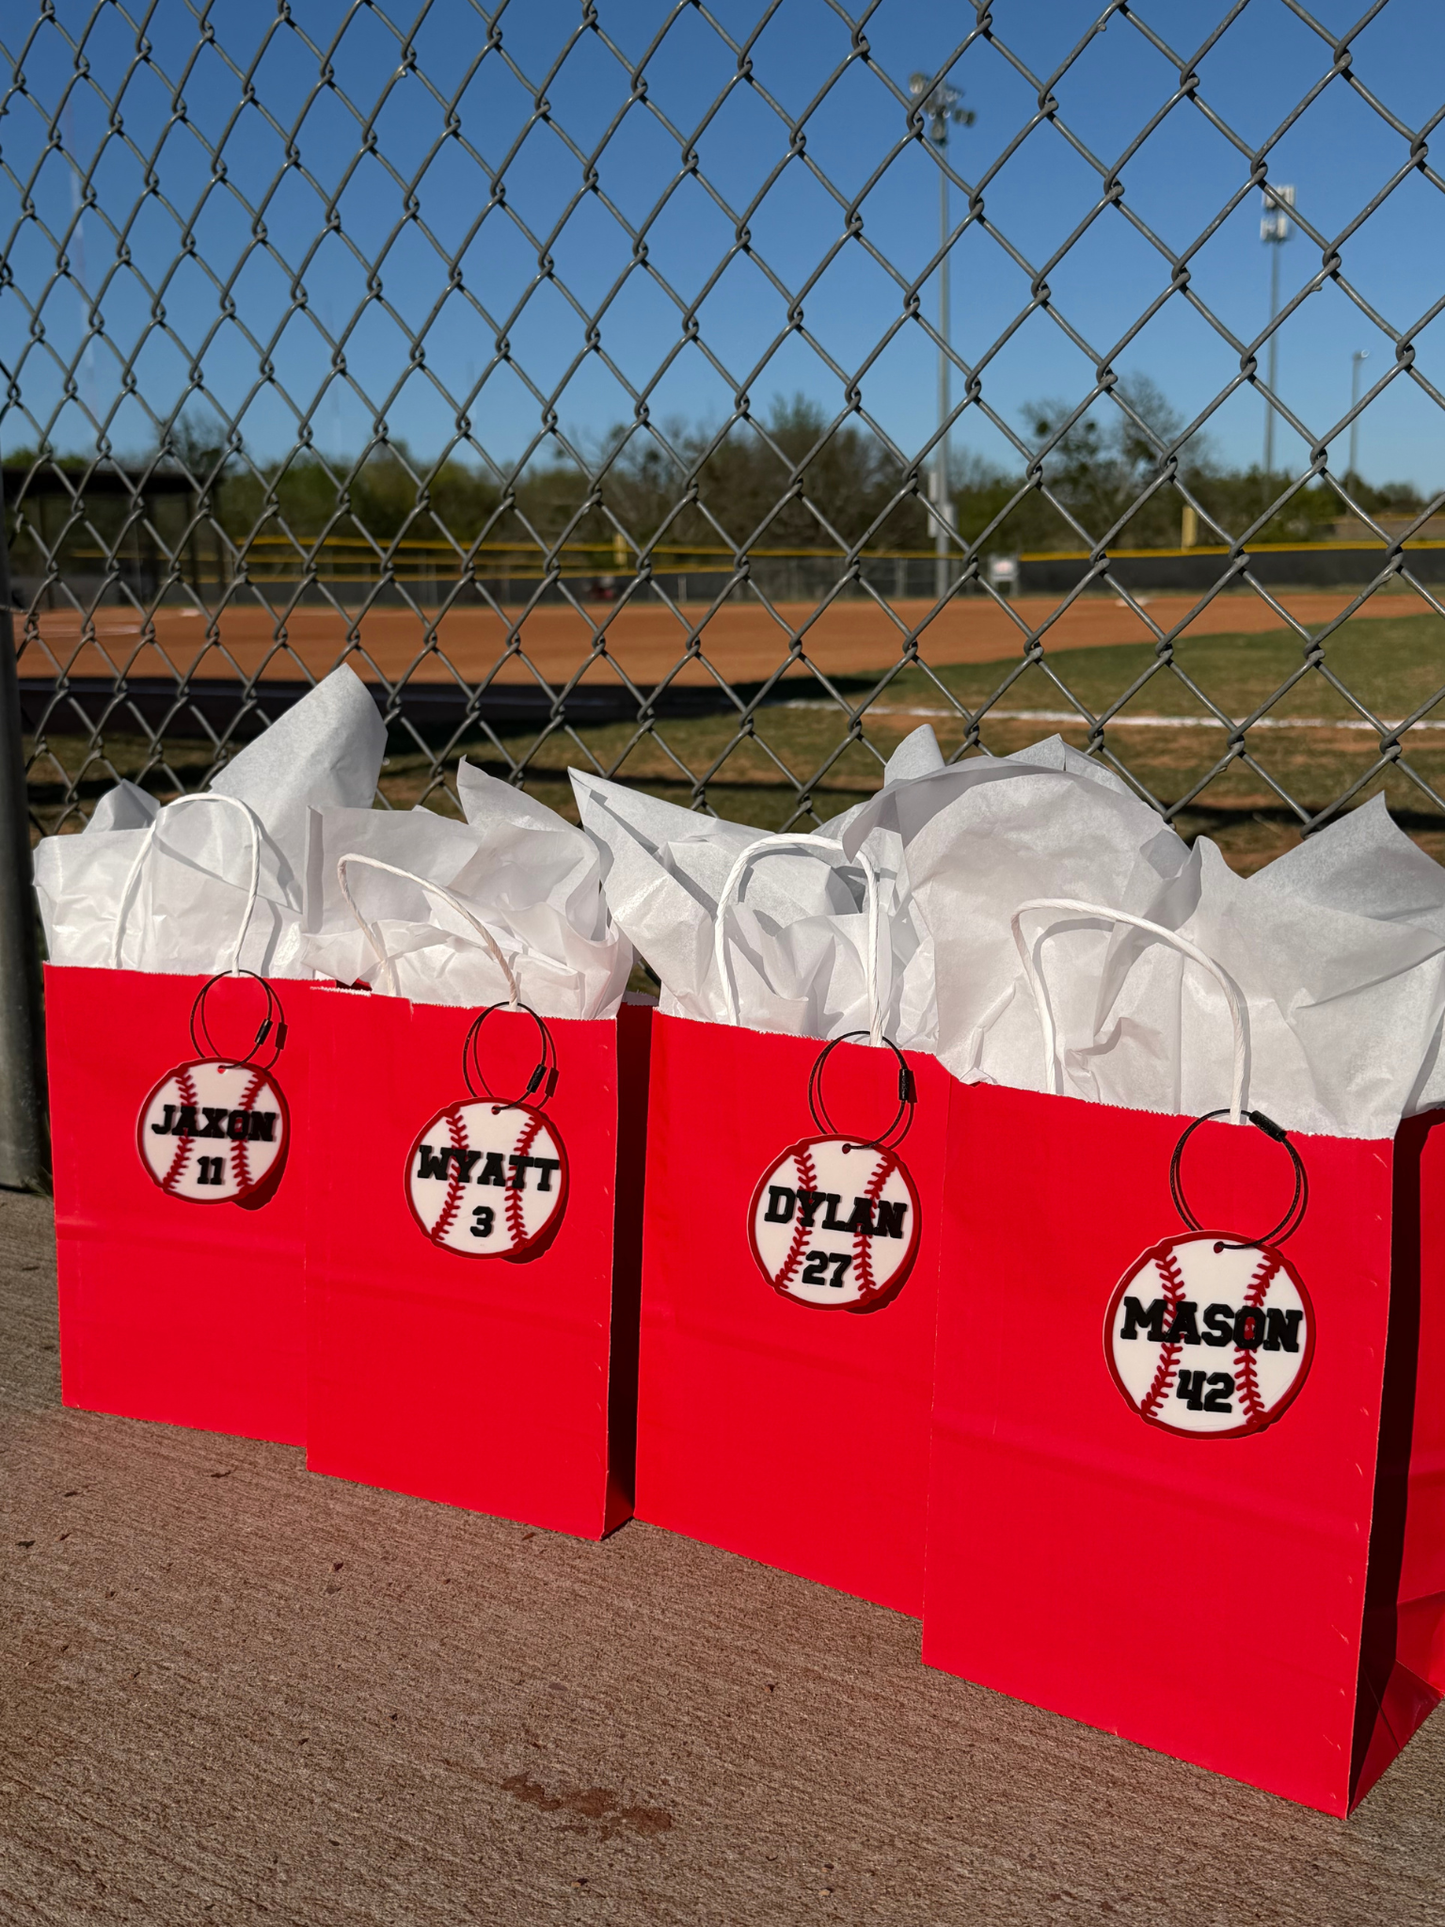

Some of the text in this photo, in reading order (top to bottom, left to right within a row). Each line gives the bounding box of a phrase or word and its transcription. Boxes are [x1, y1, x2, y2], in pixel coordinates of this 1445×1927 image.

[151, 1104, 277, 1142] JAXON
[197, 1156, 224, 1186] 11
[417, 1144, 561, 1192] WYATT
[469, 1205, 495, 1238] 3
[764, 1185, 908, 1239] DYLAN
[801, 1250, 853, 1288] 27
[1120, 1296, 1303, 1353] MASON
[1176, 1369, 1235, 1413] 42
